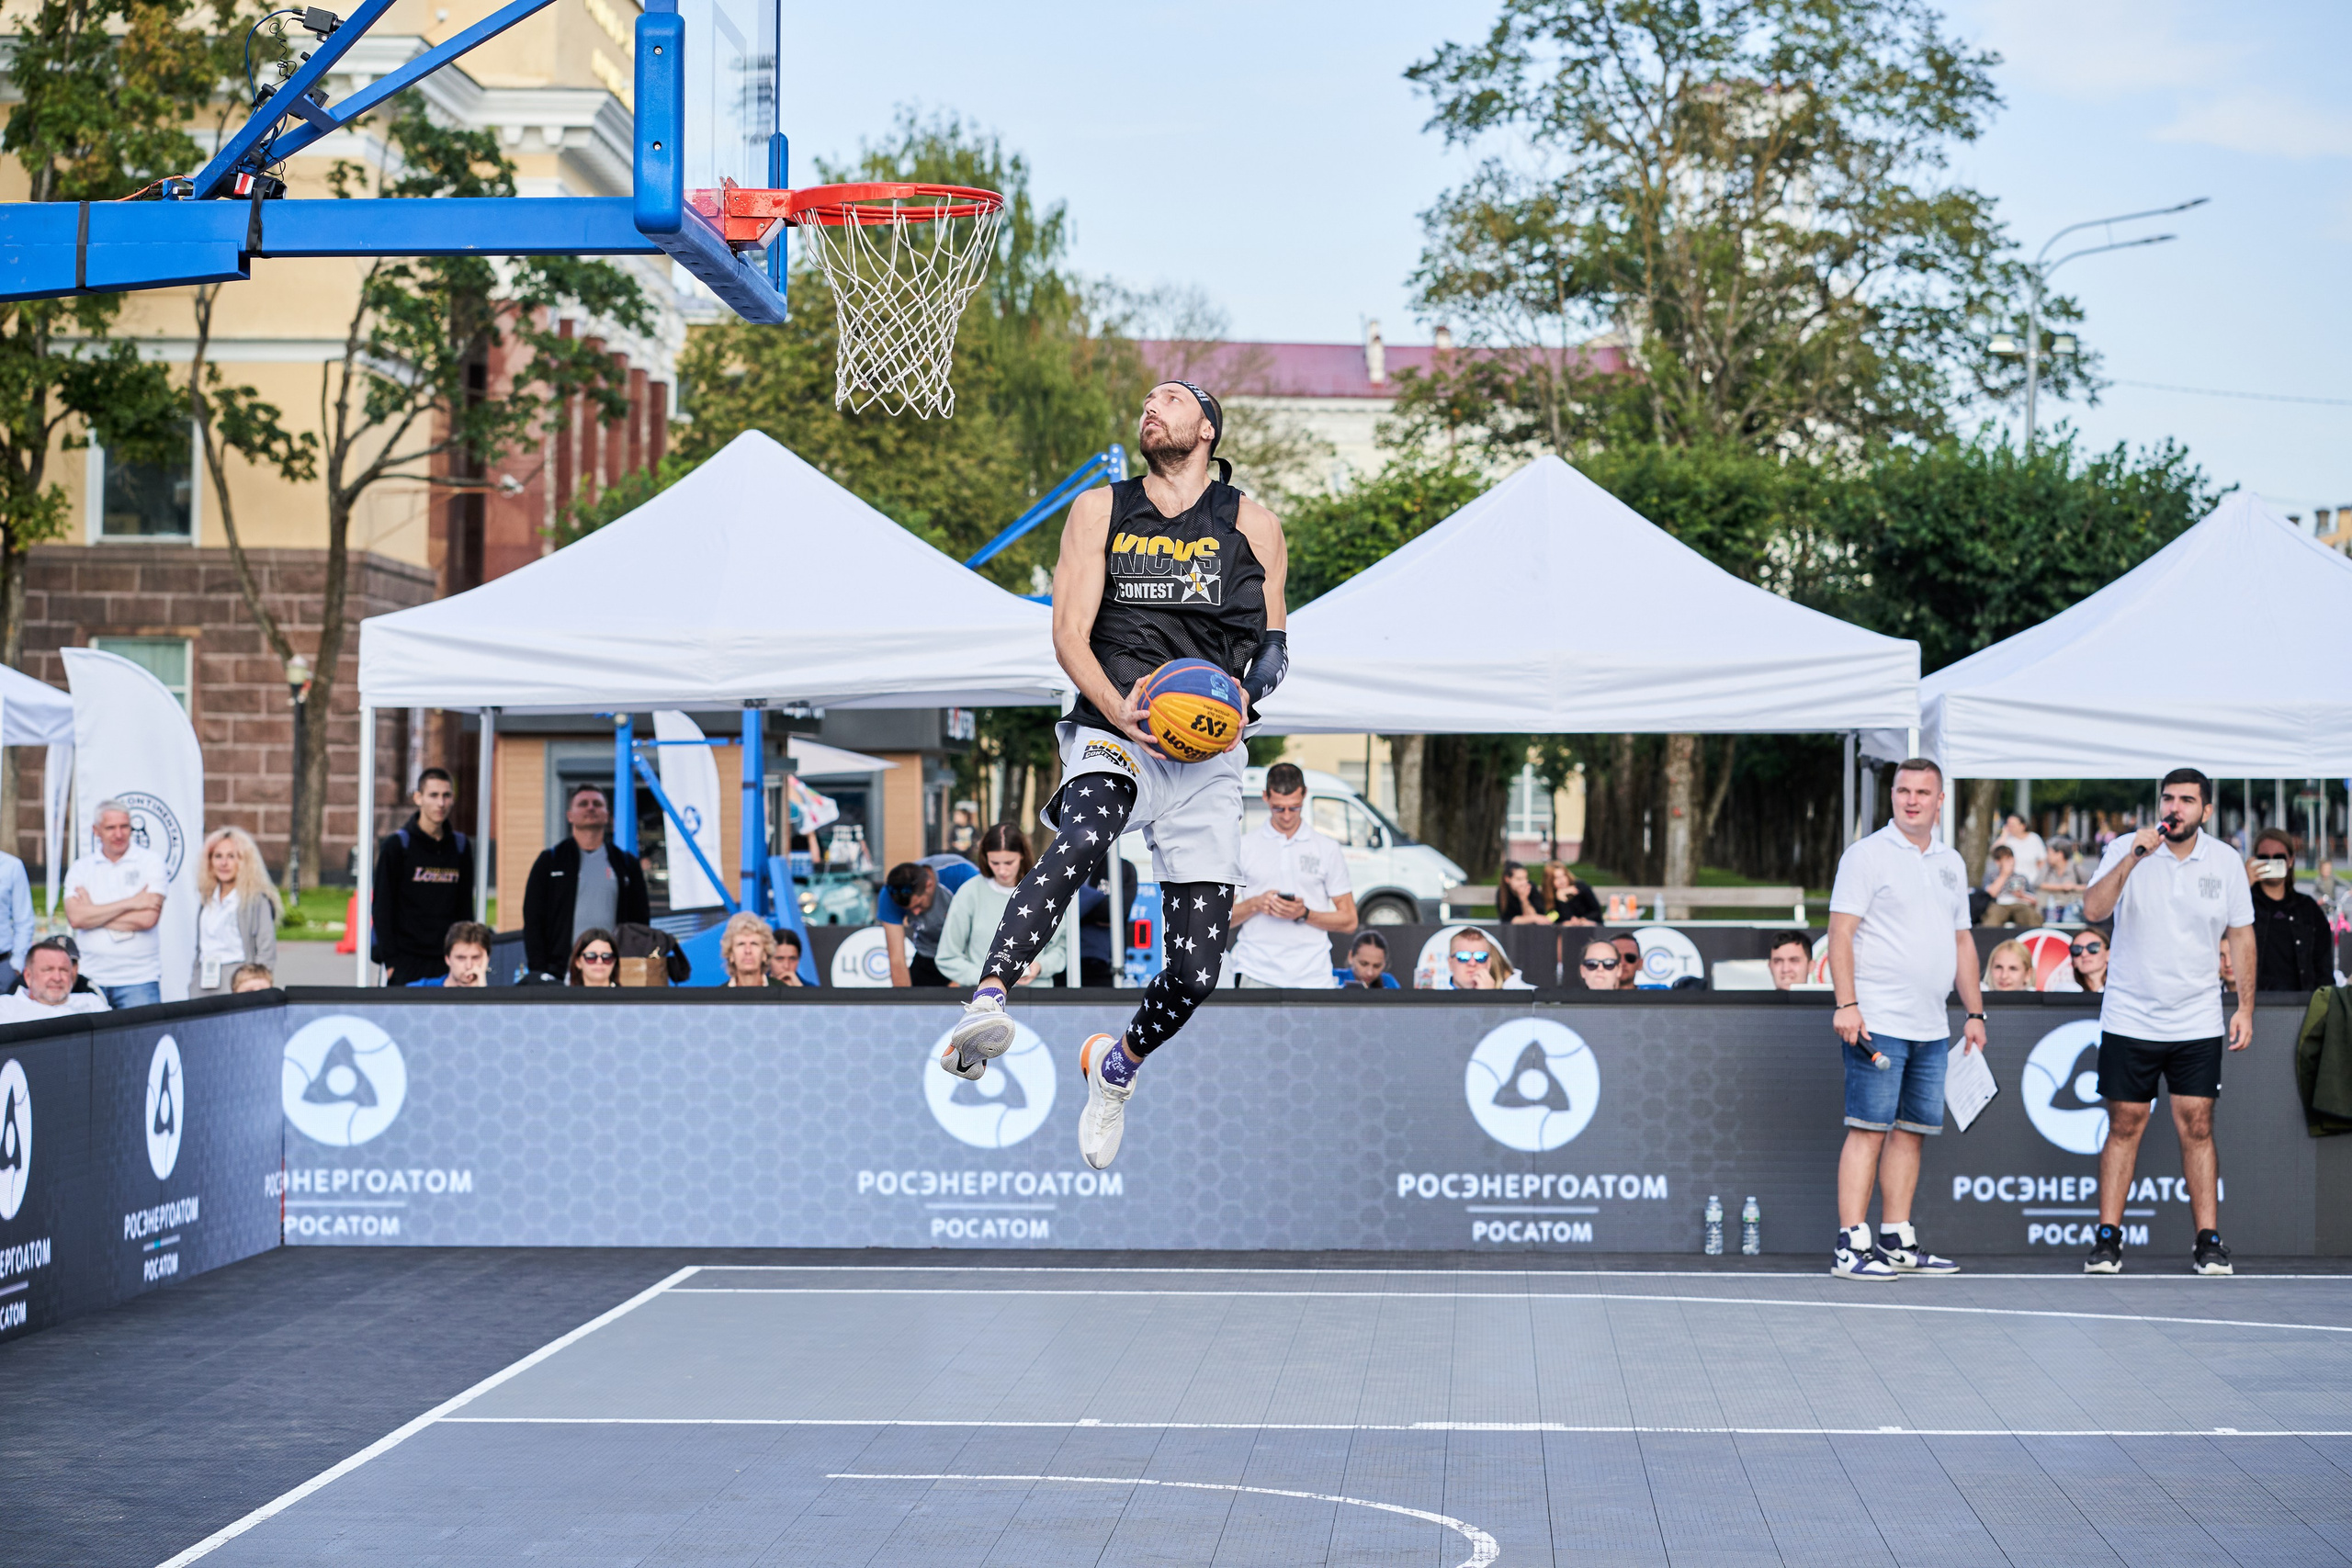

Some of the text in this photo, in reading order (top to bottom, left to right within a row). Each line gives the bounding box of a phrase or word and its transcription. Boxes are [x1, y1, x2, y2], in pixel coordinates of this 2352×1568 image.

[1111, 533, 1221, 576] KICKS
[1118, 582, 1175, 599] CONTEST
[1084, 739, 1140, 778] KICKS
[857, 1170, 1124, 1197] РОСЭНЕРГОАТОМ
[1396, 1173, 1668, 1200] РОСЭНЕРГОАТОМ
[1952, 1176, 2224, 1201] РОСЭНЕРАТО
[124, 1196, 199, 1241] РОСЭНЕРГОАТОМ
[284, 1214, 401, 1236] РОСАТОМ
[930, 1217, 1050, 1240] РОСАТОМ
[1472, 1220, 1594, 1244] РОСАТОМ
[2027, 1223, 2149, 1246] РОСАМ
[143, 1252, 178, 1282] РОСАТОМ
